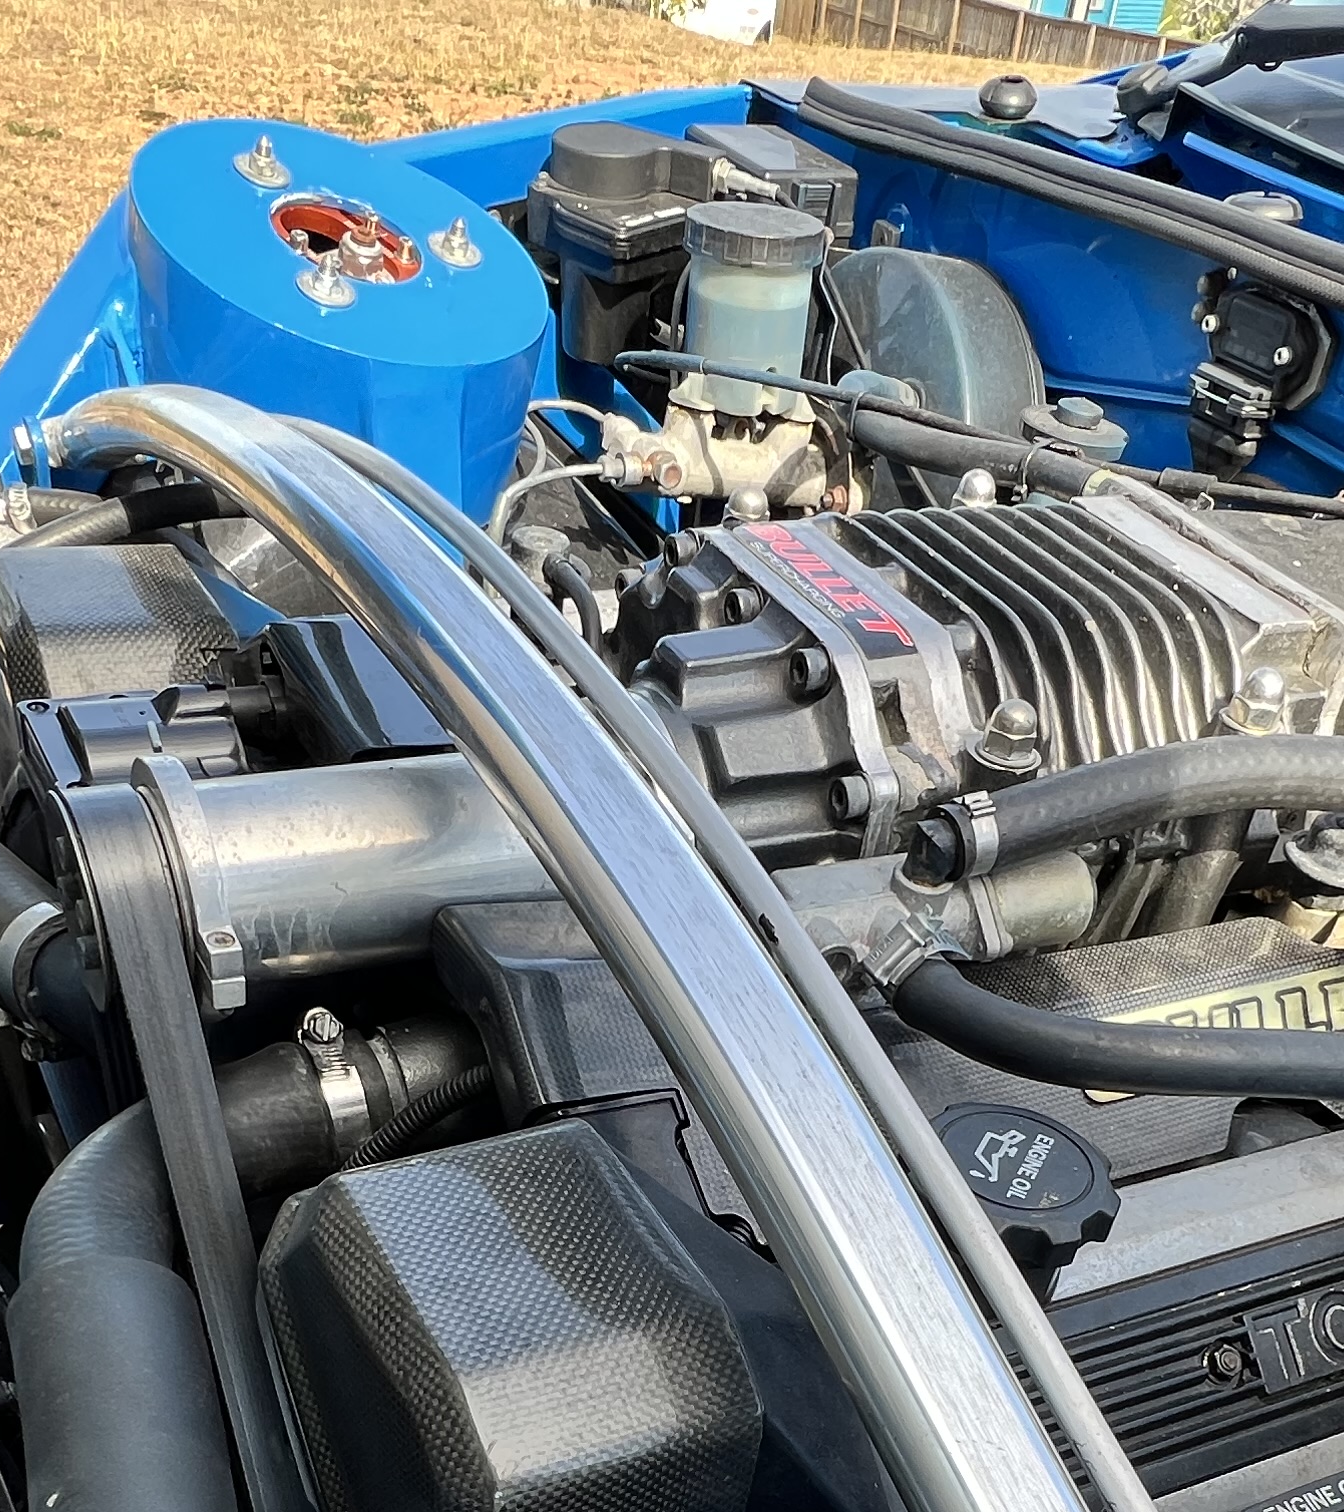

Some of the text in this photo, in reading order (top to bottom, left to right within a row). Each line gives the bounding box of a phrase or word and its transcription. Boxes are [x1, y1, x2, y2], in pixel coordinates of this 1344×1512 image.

[743, 523, 915, 648] BULLET
[749, 541, 846, 619] SUPERCHARGING
[1006, 1133, 1055, 1199] ENGINE OIL
